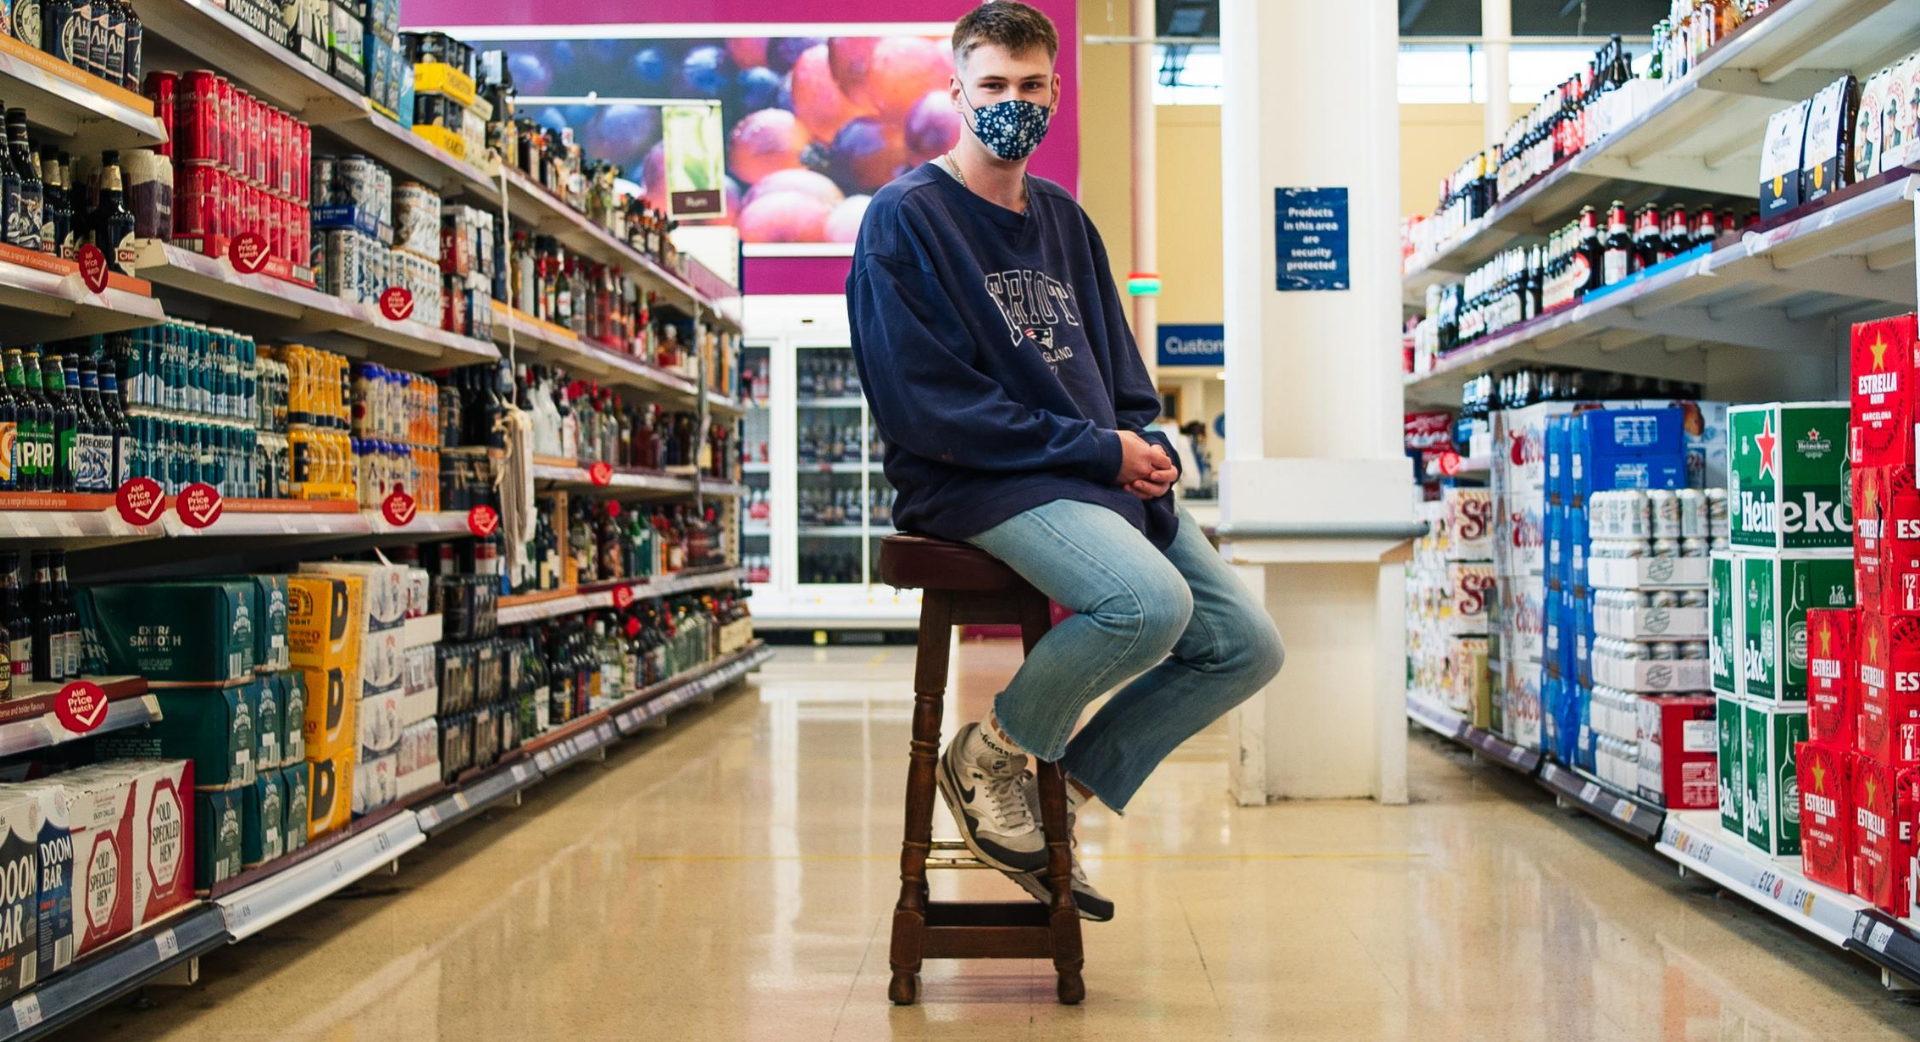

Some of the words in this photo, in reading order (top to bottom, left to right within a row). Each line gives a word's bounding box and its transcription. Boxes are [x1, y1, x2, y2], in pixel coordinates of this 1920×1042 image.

[268, 18, 288, 46] STOUT
[685, 196, 708, 208] Rum
[1288, 207, 1334, 218] Products
[1284, 221, 1294, 230] in
[1295, 221, 1314, 231] this
[1316, 222, 1338, 231] area
[1303, 235, 1320, 244] are
[238, 244, 258, 252] Price
[1291, 248, 1332, 260] security
[1287, 260, 1337, 272] protected
[1858, 372, 1897, 395] ESTRELLA
[1862, 411, 1892, 421] BARCELONA
[131, 484, 144, 493] Aldi
[127, 491, 150, 501] Price
[187, 496, 209, 505] Price
[130, 499, 152, 509] Match
[189, 503, 210, 512] Match
[1741, 491, 1776, 532] Hein
[1904, 574, 1916, 589] 12
[1830, 585, 1844, 594] 12
[130, 635, 181, 647] SMOOTH
[1812, 658, 1841, 678] ESTRELLA
[1861, 664, 1884, 689] ESTRELLA
[71, 688, 86, 698] Aldi
[68, 695, 93, 706] Price
[70, 702, 94, 714] Match
[1902, 725, 1914, 739] 12
[1804, 792, 1836, 818] ESTRELLA
[1858, 807, 1886, 837] ESTRELLA
[152, 820, 179, 846] SPECKLED
[1810, 828, 1834, 842] BARCELONA
[40, 836, 72, 868] DOOM
[1860, 846, 1882, 862] BARCELONA
[42, 863, 63, 892] BAR
[90, 867, 116, 892] SPECKLED
[1758, 872, 1774, 891] £12
